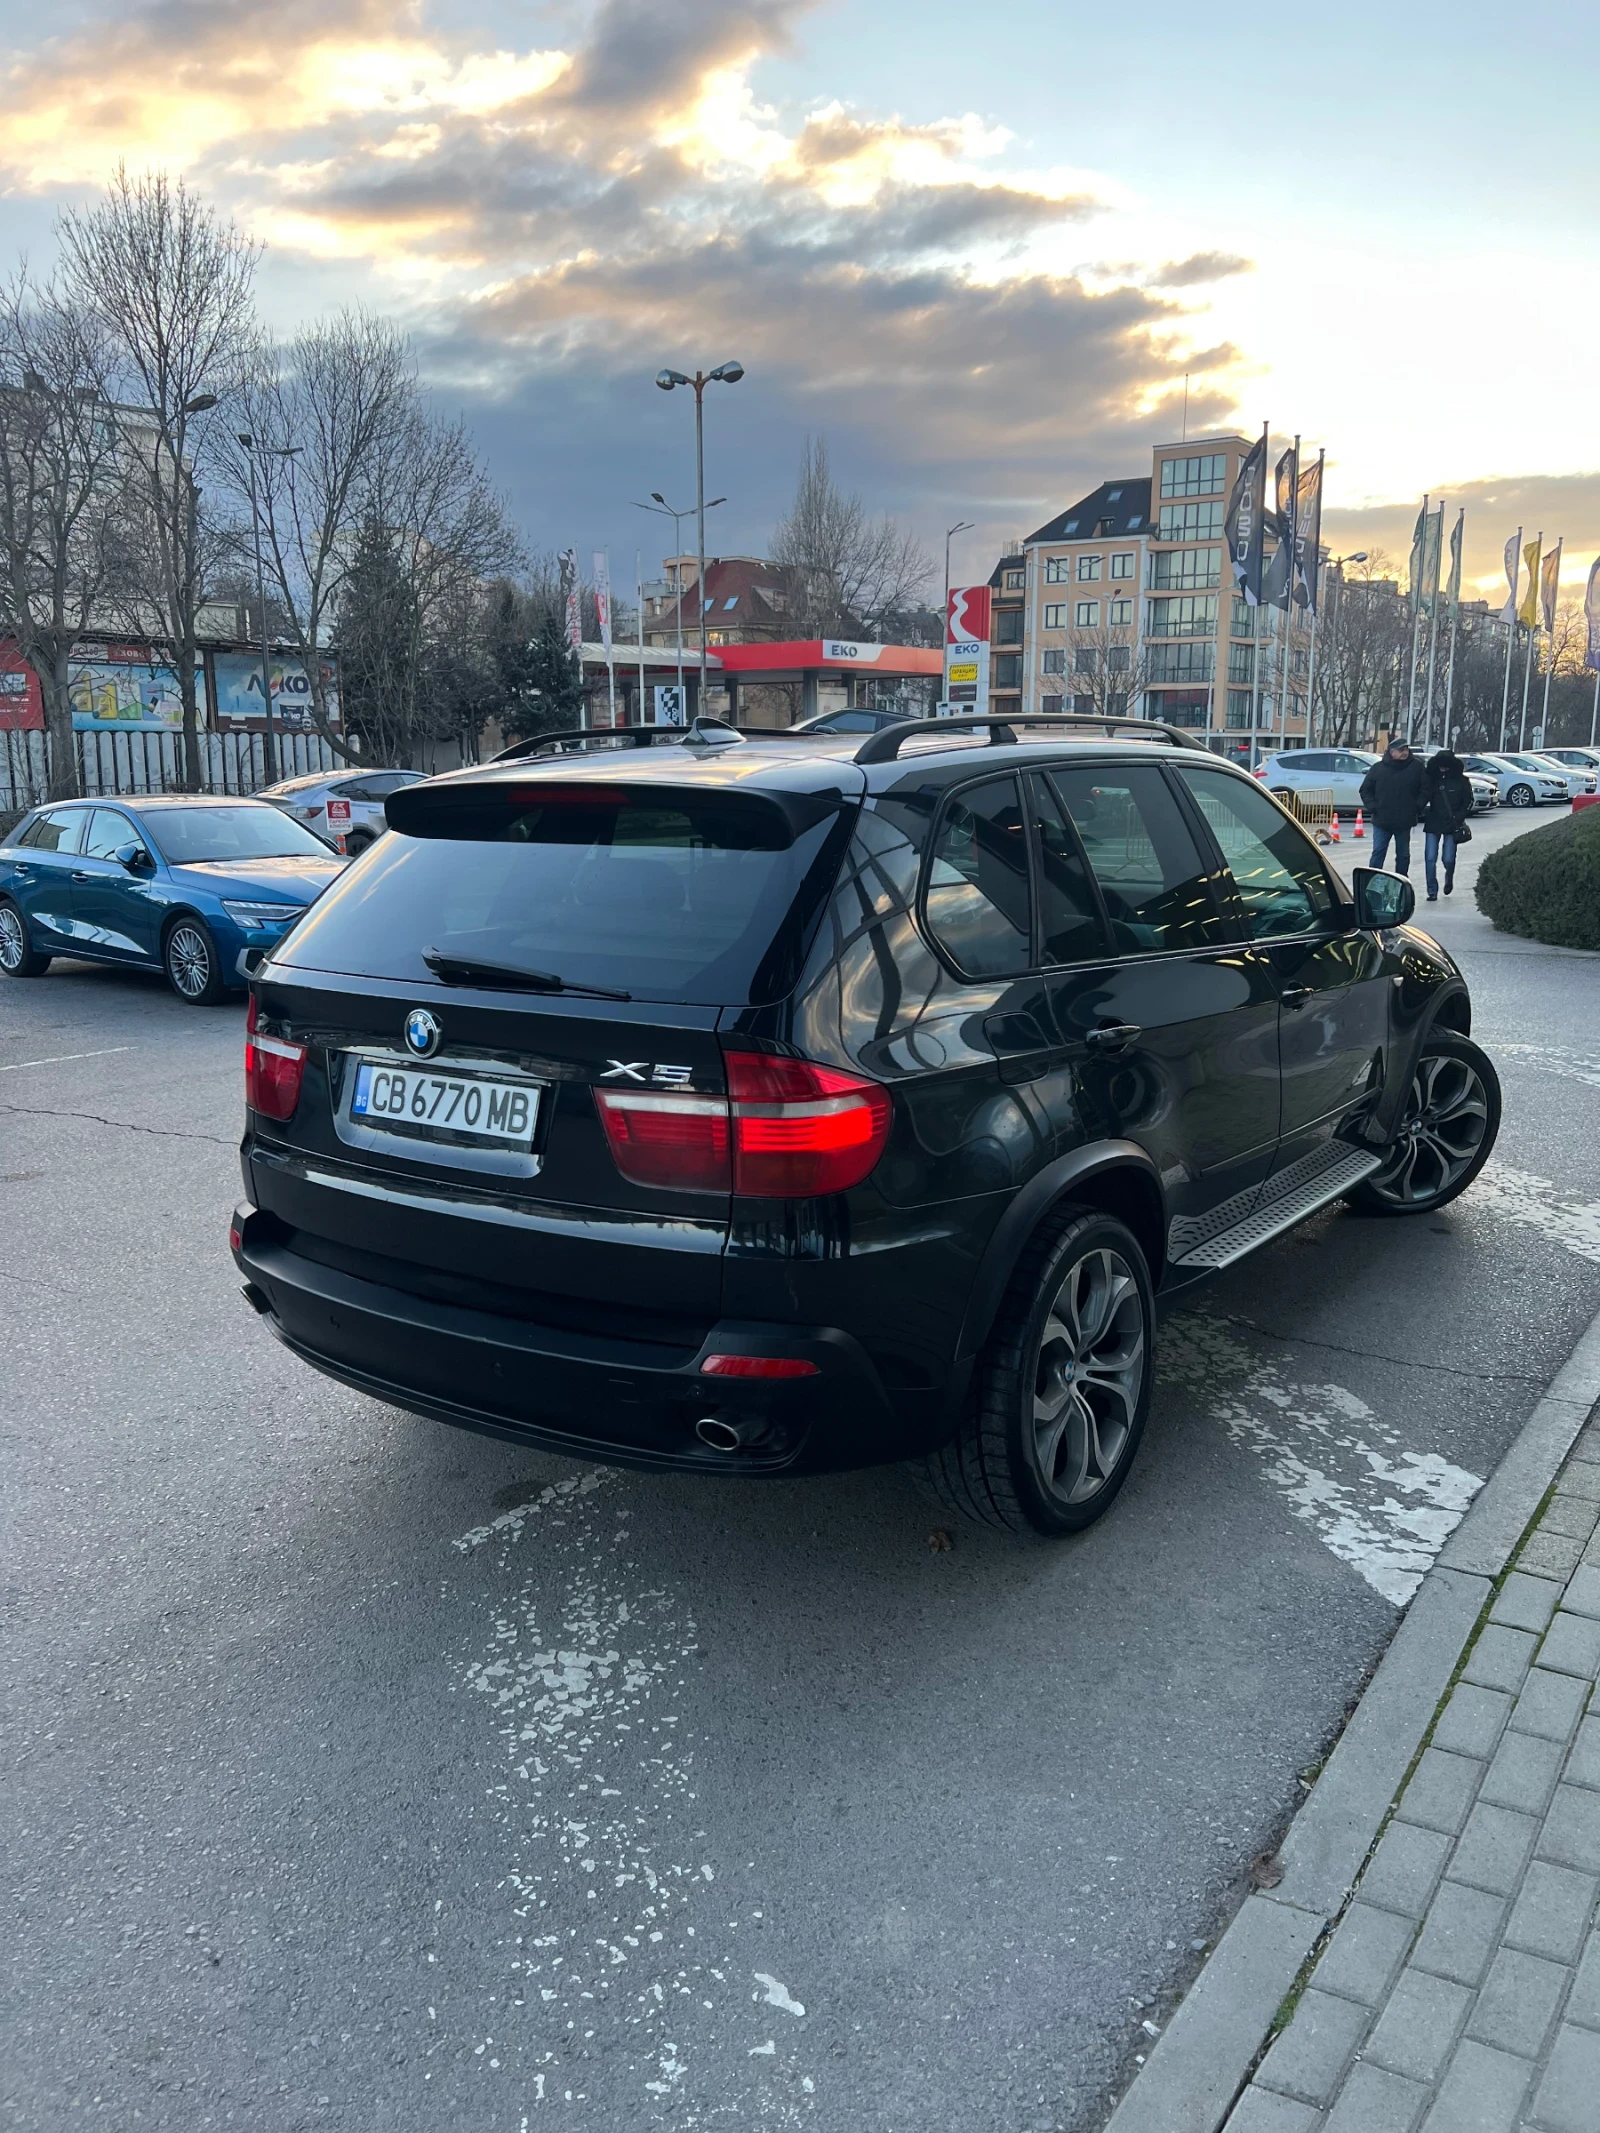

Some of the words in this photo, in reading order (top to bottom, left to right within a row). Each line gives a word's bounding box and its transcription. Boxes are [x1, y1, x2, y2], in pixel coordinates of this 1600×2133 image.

[831, 645, 858, 657] EKO
[955, 644, 980, 655] EKO
[600, 1059, 693, 1084] X5
[355, 1095, 367, 1107] BG
[372, 1072, 407, 1114] CB
[411, 1078, 482, 1126] 6770
[486, 1088, 530, 1134] MB
